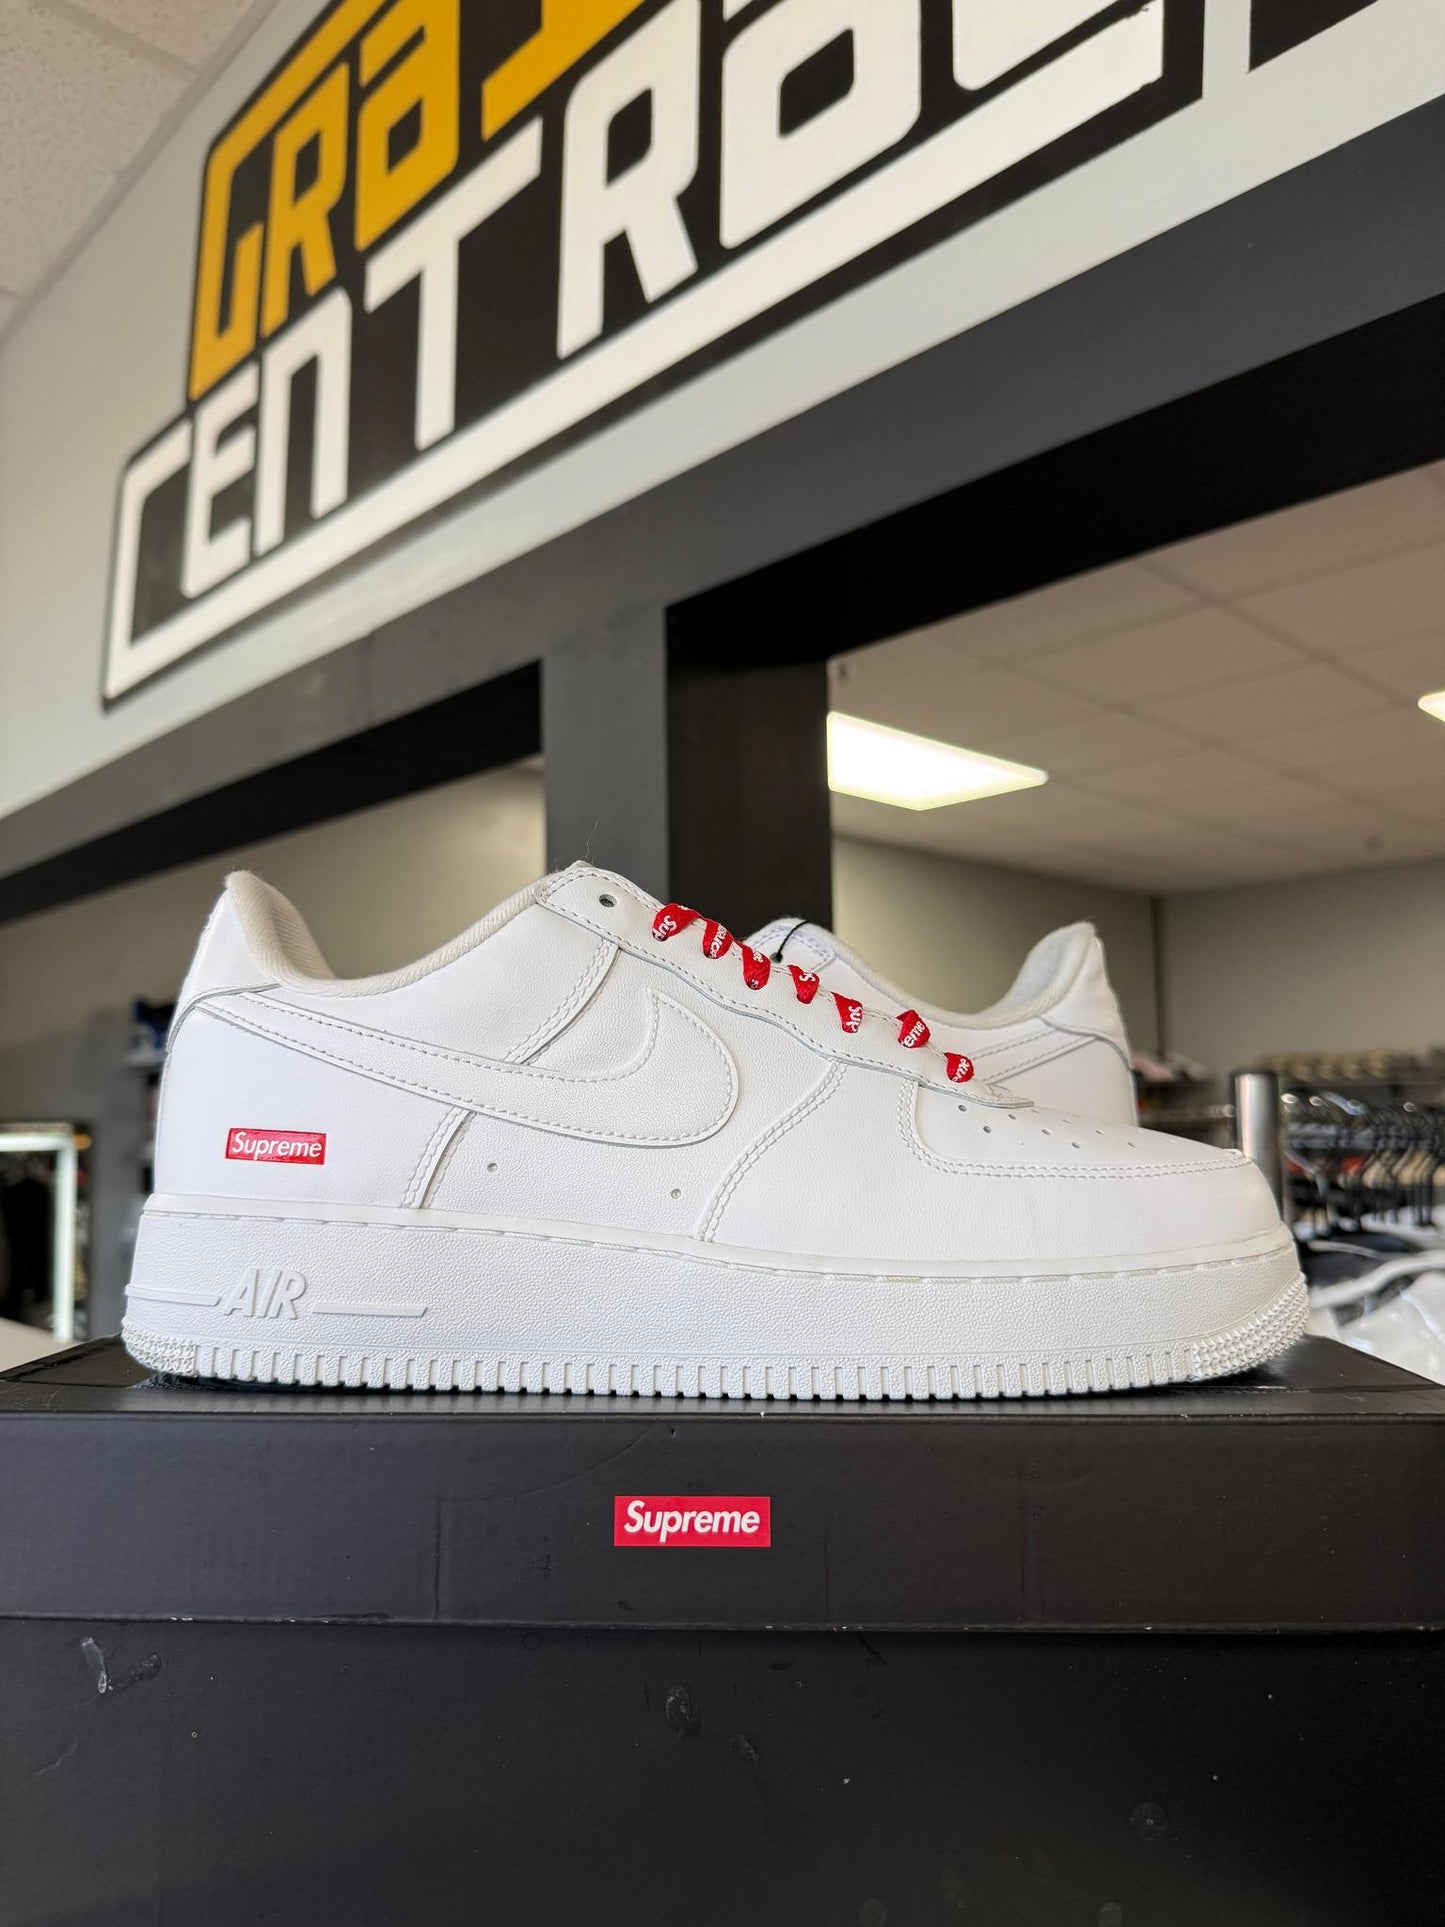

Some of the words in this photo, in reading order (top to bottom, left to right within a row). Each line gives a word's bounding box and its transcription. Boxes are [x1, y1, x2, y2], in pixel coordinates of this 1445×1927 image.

[232, 1131, 322, 1161] Supreme
[223, 1267, 307, 1320] AIR
[624, 1500, 760, 1543] Supreme
